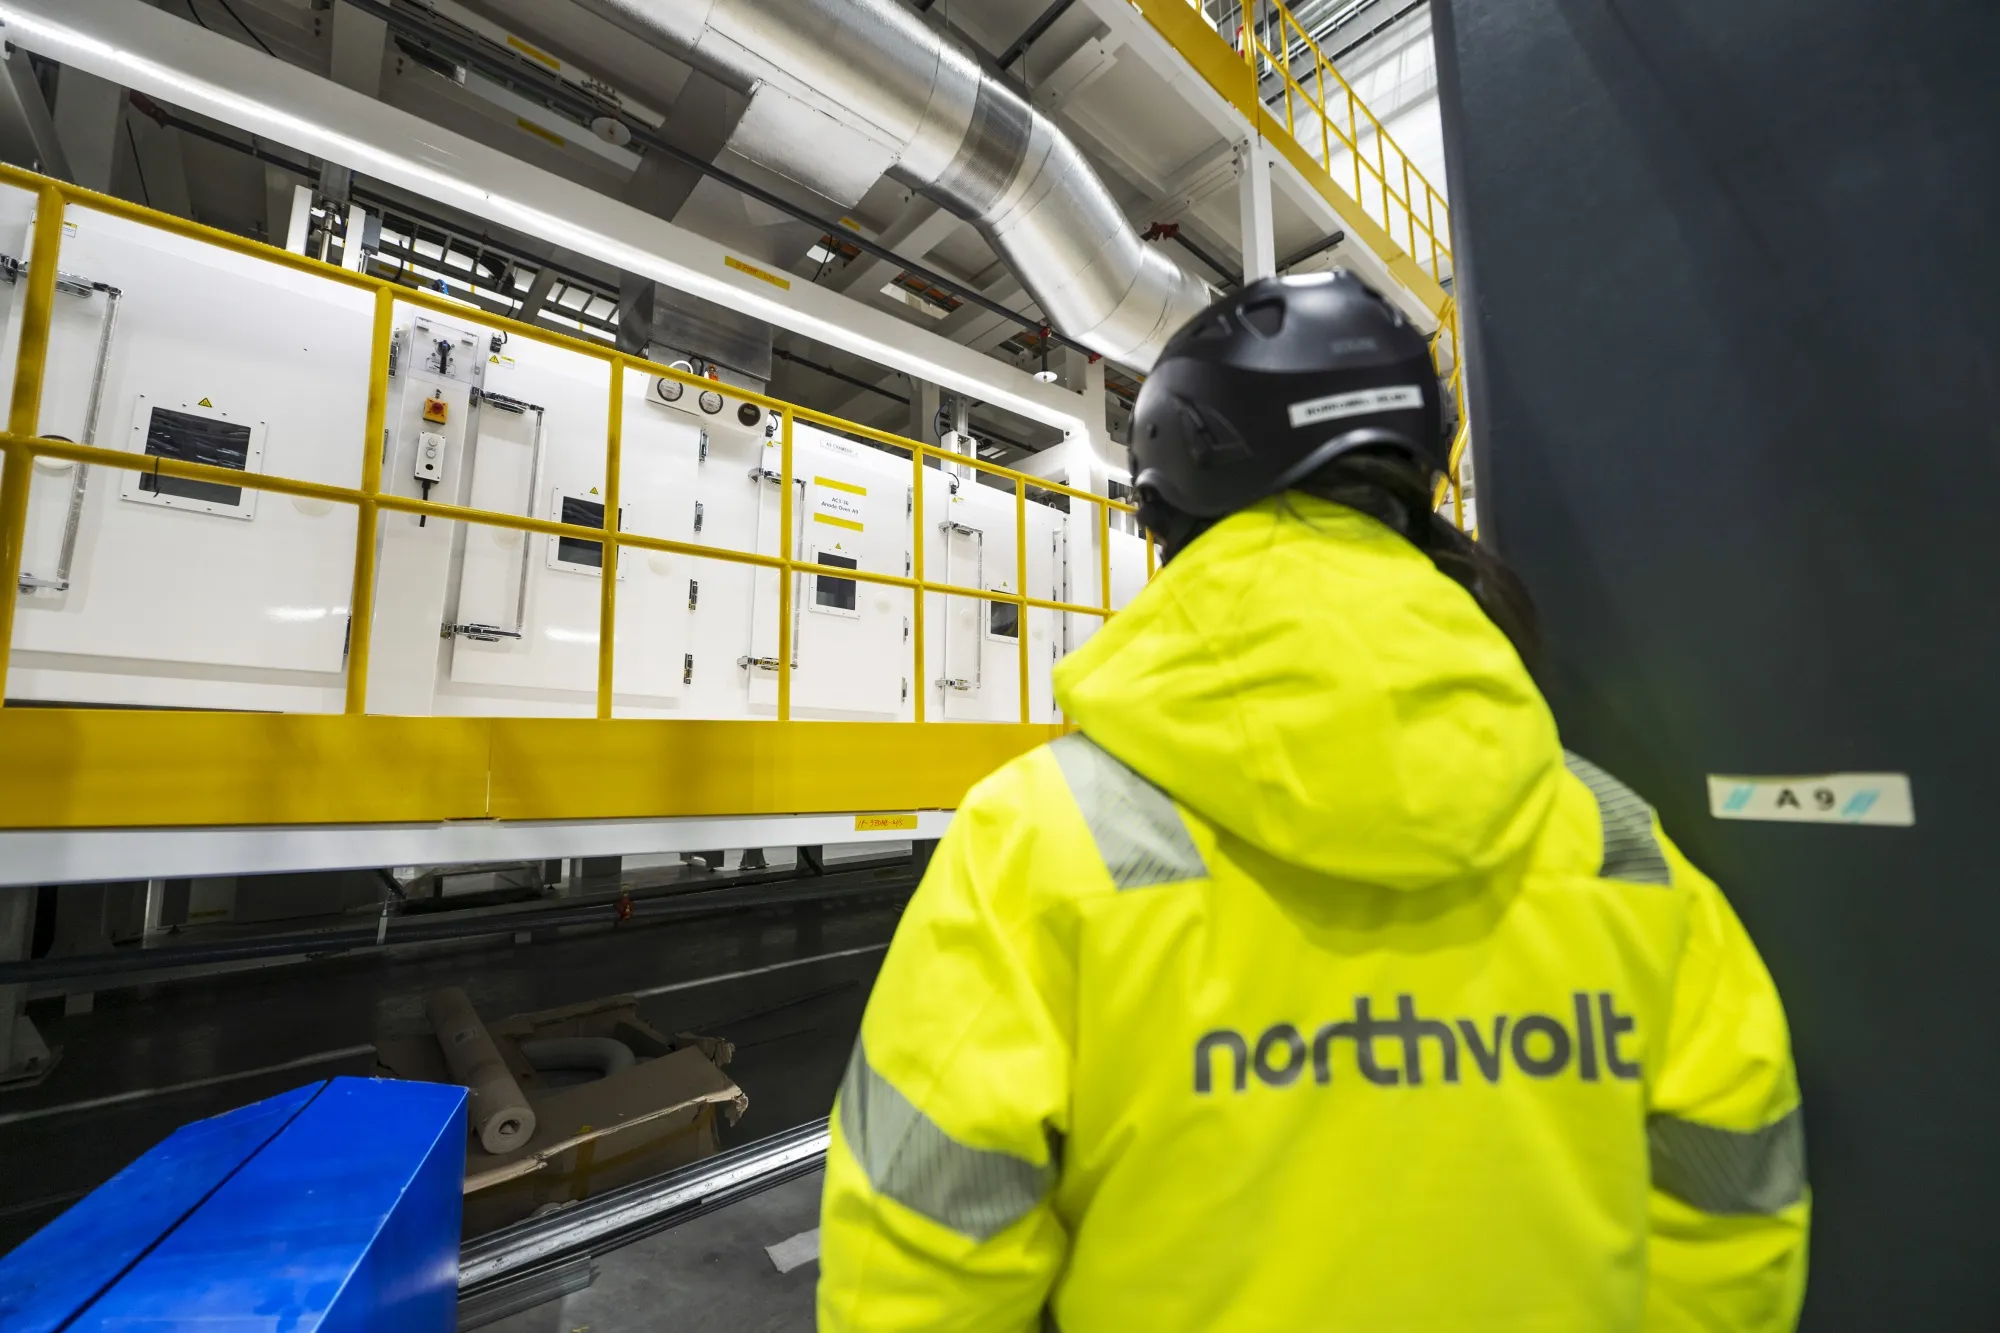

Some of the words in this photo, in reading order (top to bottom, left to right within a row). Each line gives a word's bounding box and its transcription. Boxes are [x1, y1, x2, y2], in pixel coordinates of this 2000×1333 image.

[821, 501, 837, 510] Anode
[838, 505, 851, 513] Oven
[1776, 788, 1801, 810] A
[1814, 788, 1836, 811] 9
[1194, 992, 1643, 1094] northvolt
